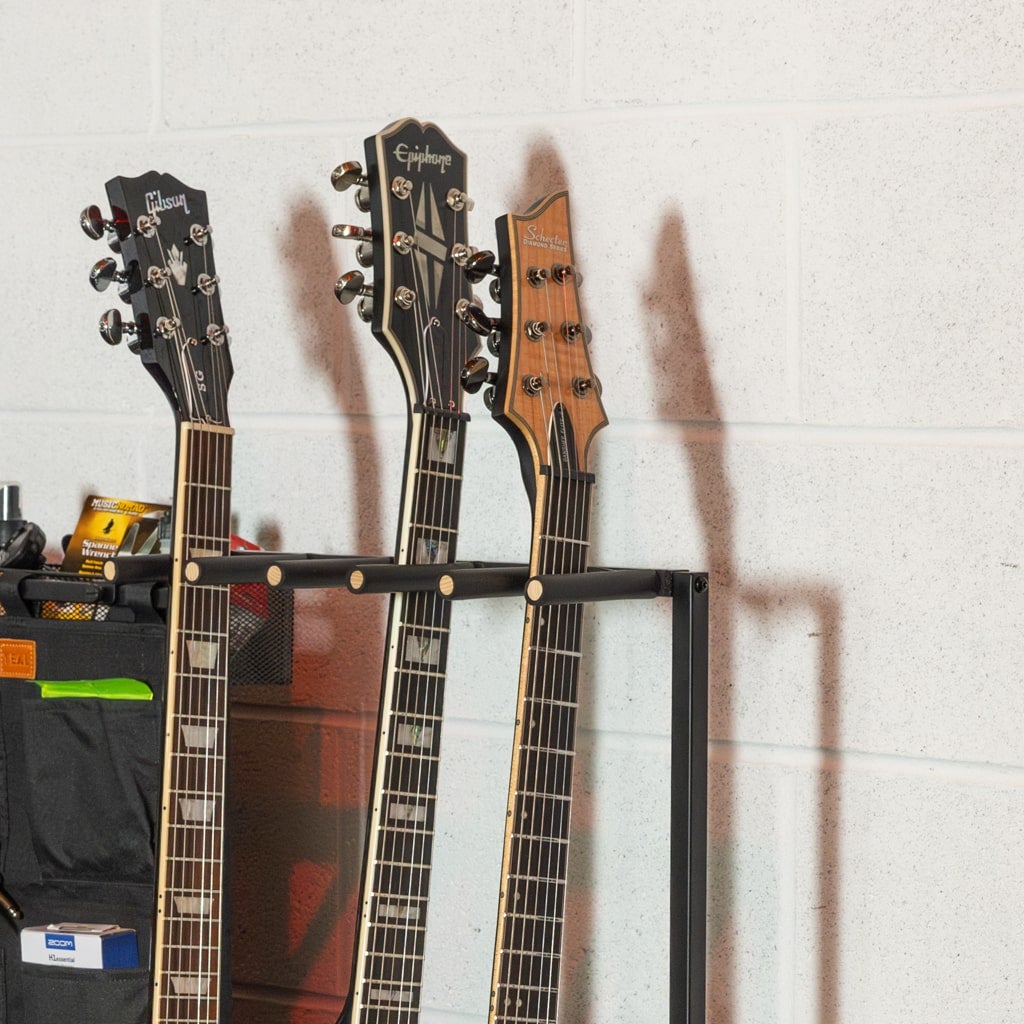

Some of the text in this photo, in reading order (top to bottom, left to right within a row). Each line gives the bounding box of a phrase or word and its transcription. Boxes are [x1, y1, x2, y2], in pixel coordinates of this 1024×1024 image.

[392, 142, 452, 174] Epiphone
[144, 189, 190, 214] Gibson
[47, 939, 74, 948] ZOOM
